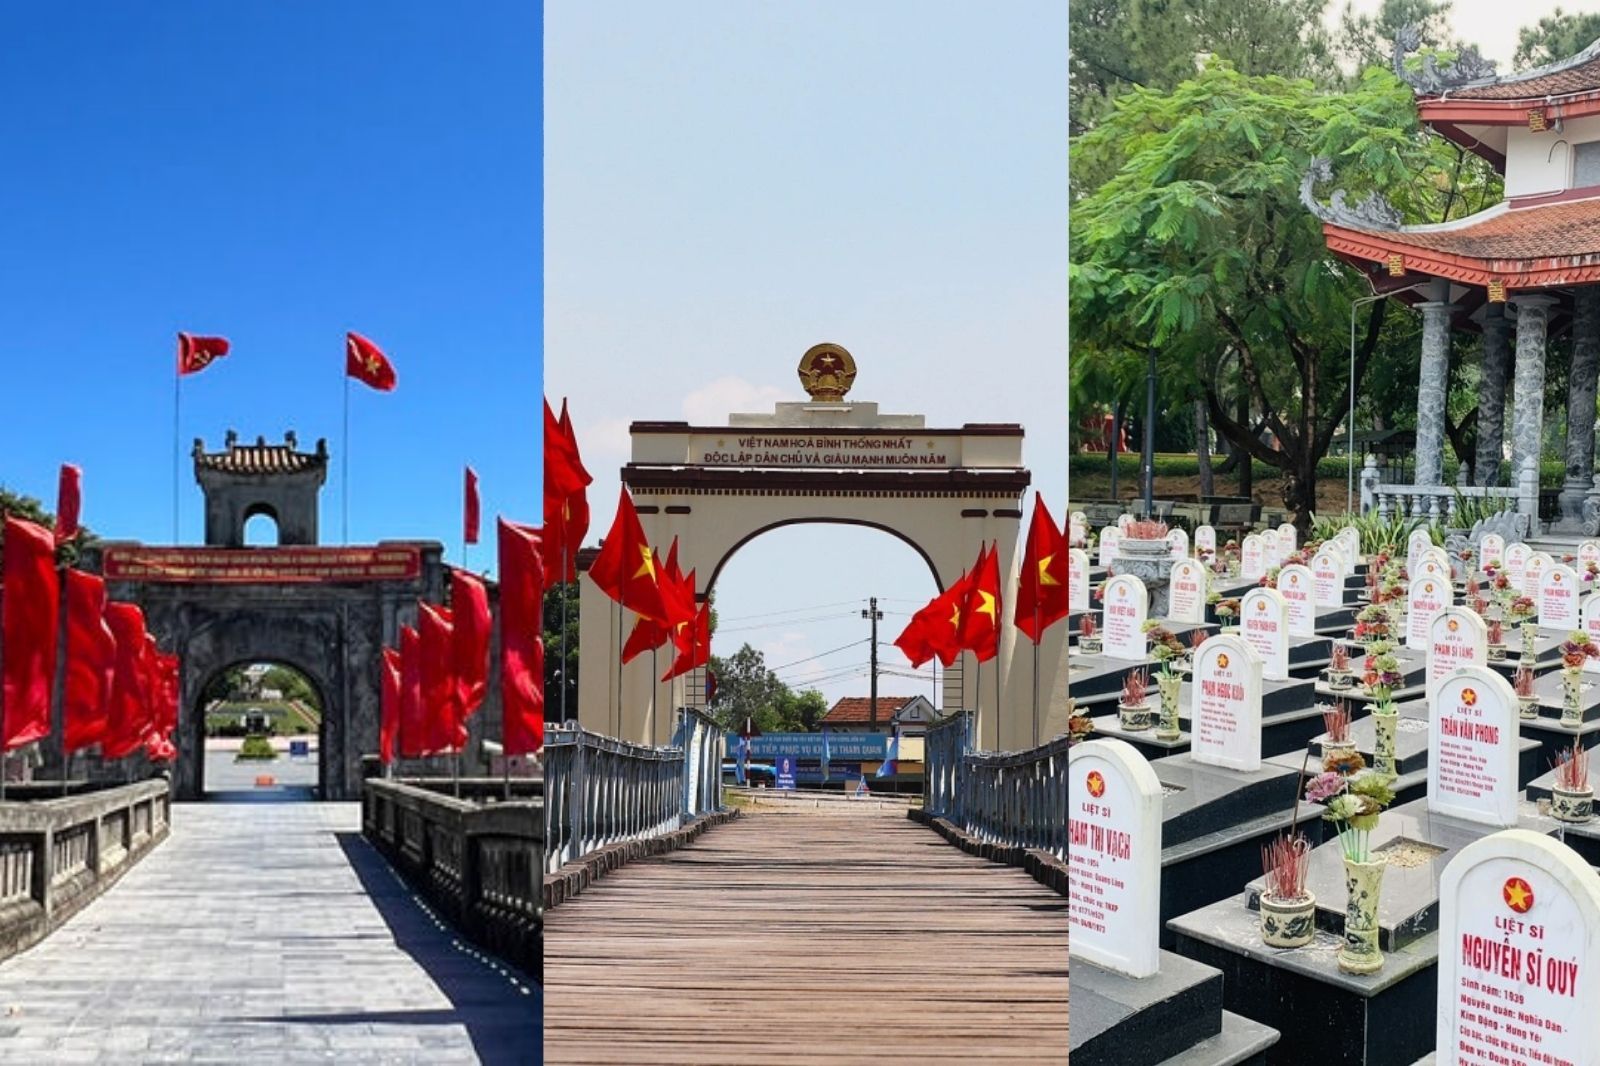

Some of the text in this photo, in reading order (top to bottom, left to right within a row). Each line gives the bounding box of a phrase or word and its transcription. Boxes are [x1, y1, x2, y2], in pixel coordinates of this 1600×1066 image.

[739, 436, 763, 449] VIỆT
[764, 439, 789, 448] NAM
[817, 437, 841, 448] BÌNH
[843, 436, 881, 449] THỐNG
[883, 436, 912, 449] NHẤT
[704, 451, 729, 464] ĐỘC
[731, 451, 752, 465] LẬP
[755, 451, 779, 463] DÂN
[781, 450, 803, 463] CHỦ
[886, 453, 918, 464] MUÔN
[921, 453, 946, 464] NĂM
[1475, 723, 1499, 745] PHONG
[1082, 802, 1100, 816] LIỆT
[1495, 915, 1545, 940] LIỆT SĨ
[1463, 932, 1578, 997] NGUYỄN SĨ QUÝ
[1461, 977, 1479, 990] Sinh
[1504, 990, 1525, 1005] 1939
[1461, 993, 1491, 1011] Nguyên
[1461, 1009, 1476, 1023] Kim
